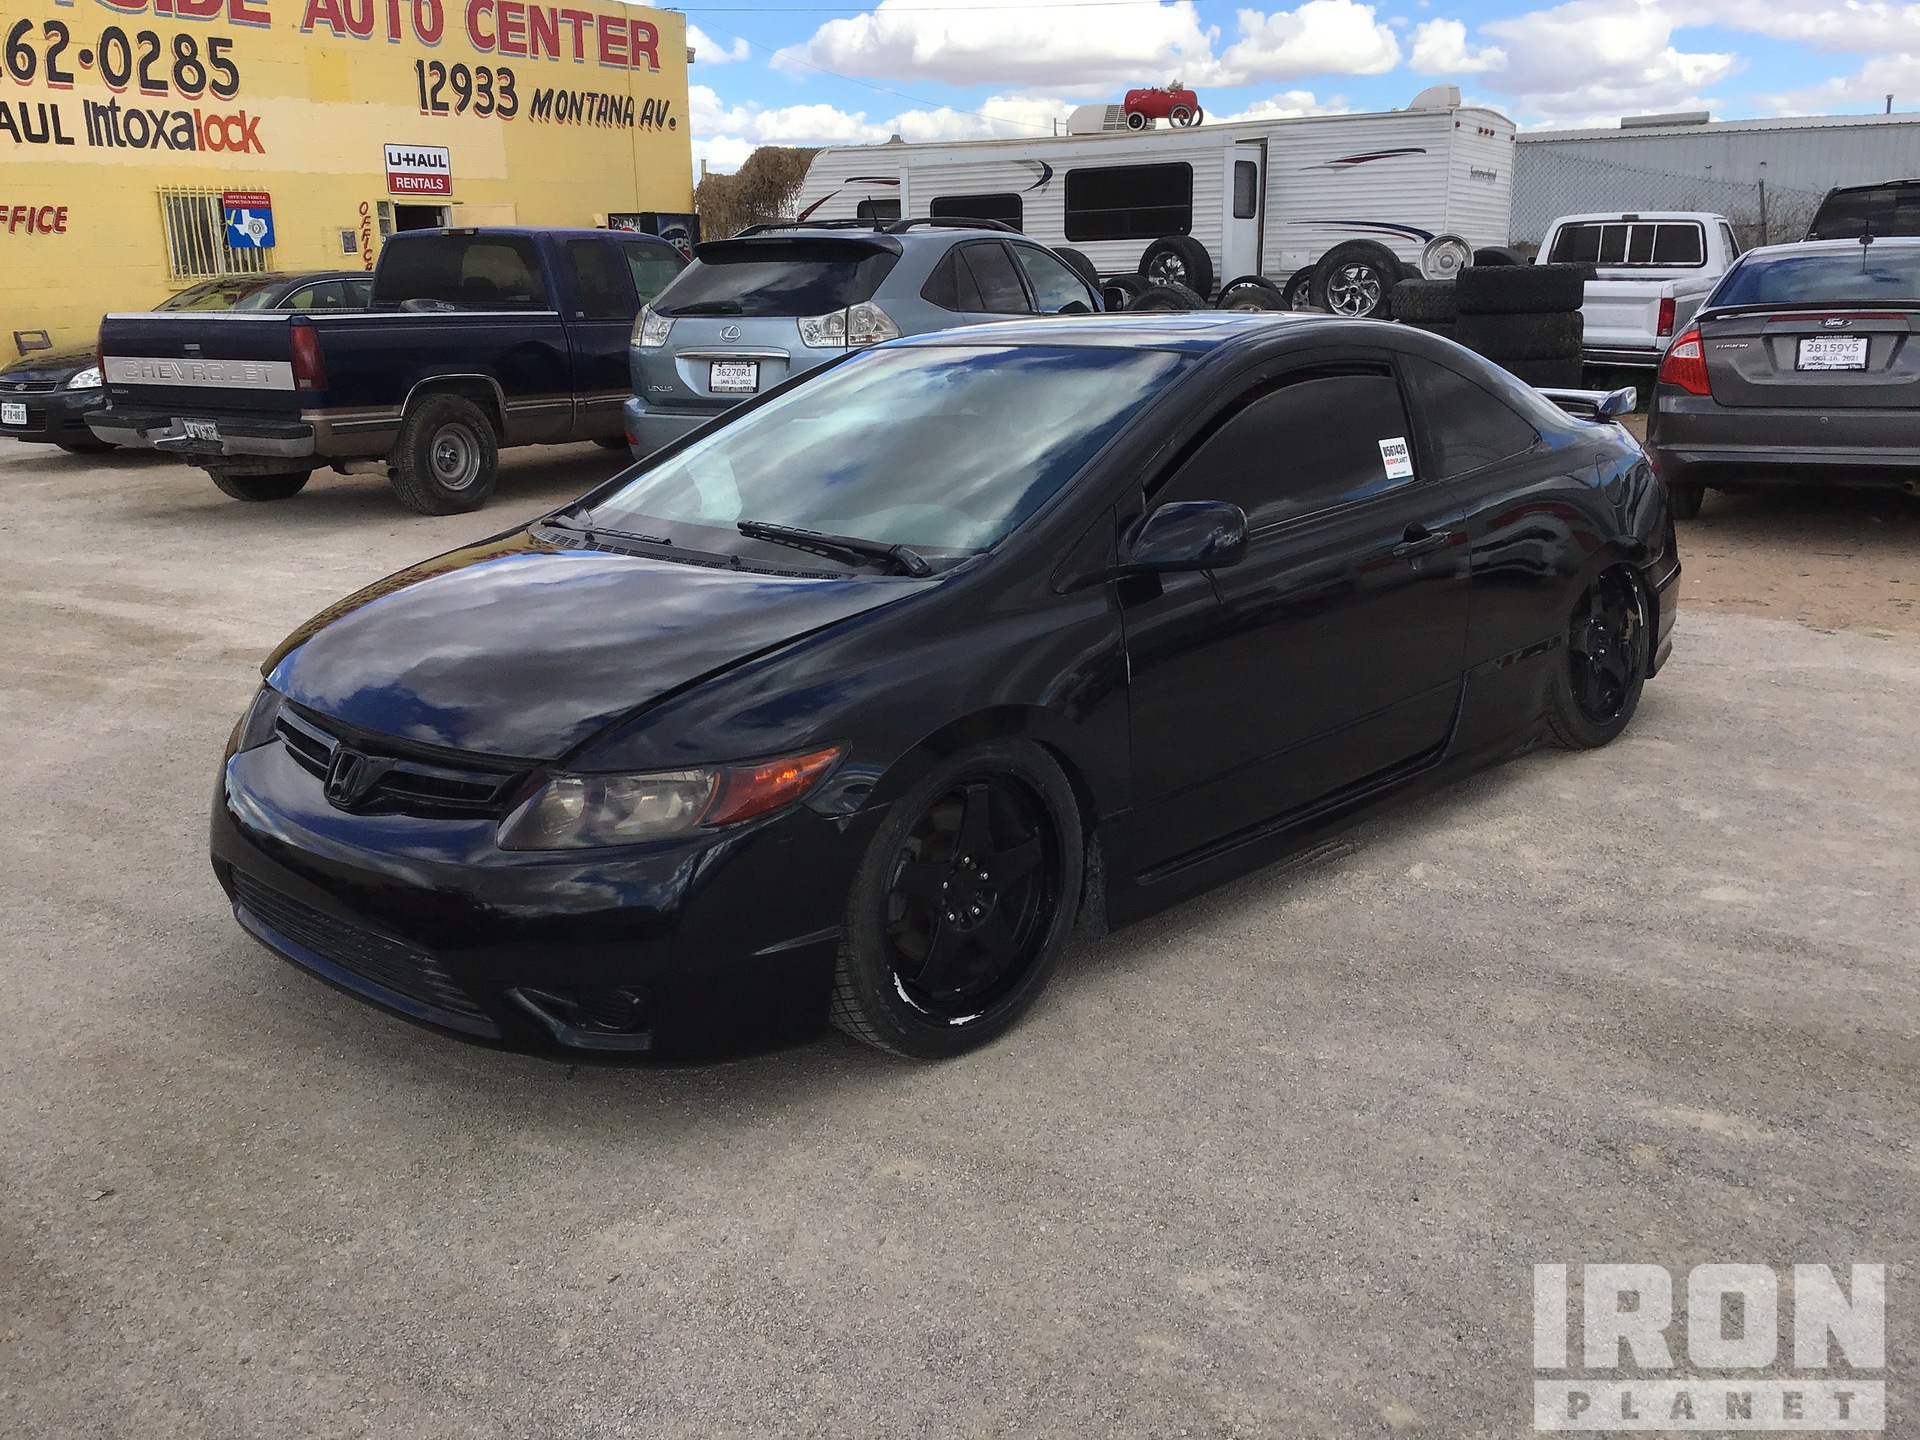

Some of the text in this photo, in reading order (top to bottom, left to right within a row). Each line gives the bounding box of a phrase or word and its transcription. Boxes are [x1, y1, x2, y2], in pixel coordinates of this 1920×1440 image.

[301, 0, 443, 48] AUTO
[464, 0, 662, 73] CENTER
[414, 59, 677, 132] 12933 MONTANA AV.
[388, 152, 447, 168] U-HAUL
[395, 176, 444, 190] RENTALS
[1807, 343, 1859, 353] 28159Y5
[122, 360, 273, 384] CHEVROLET
[716, 368, 752, 377] 36270R1
